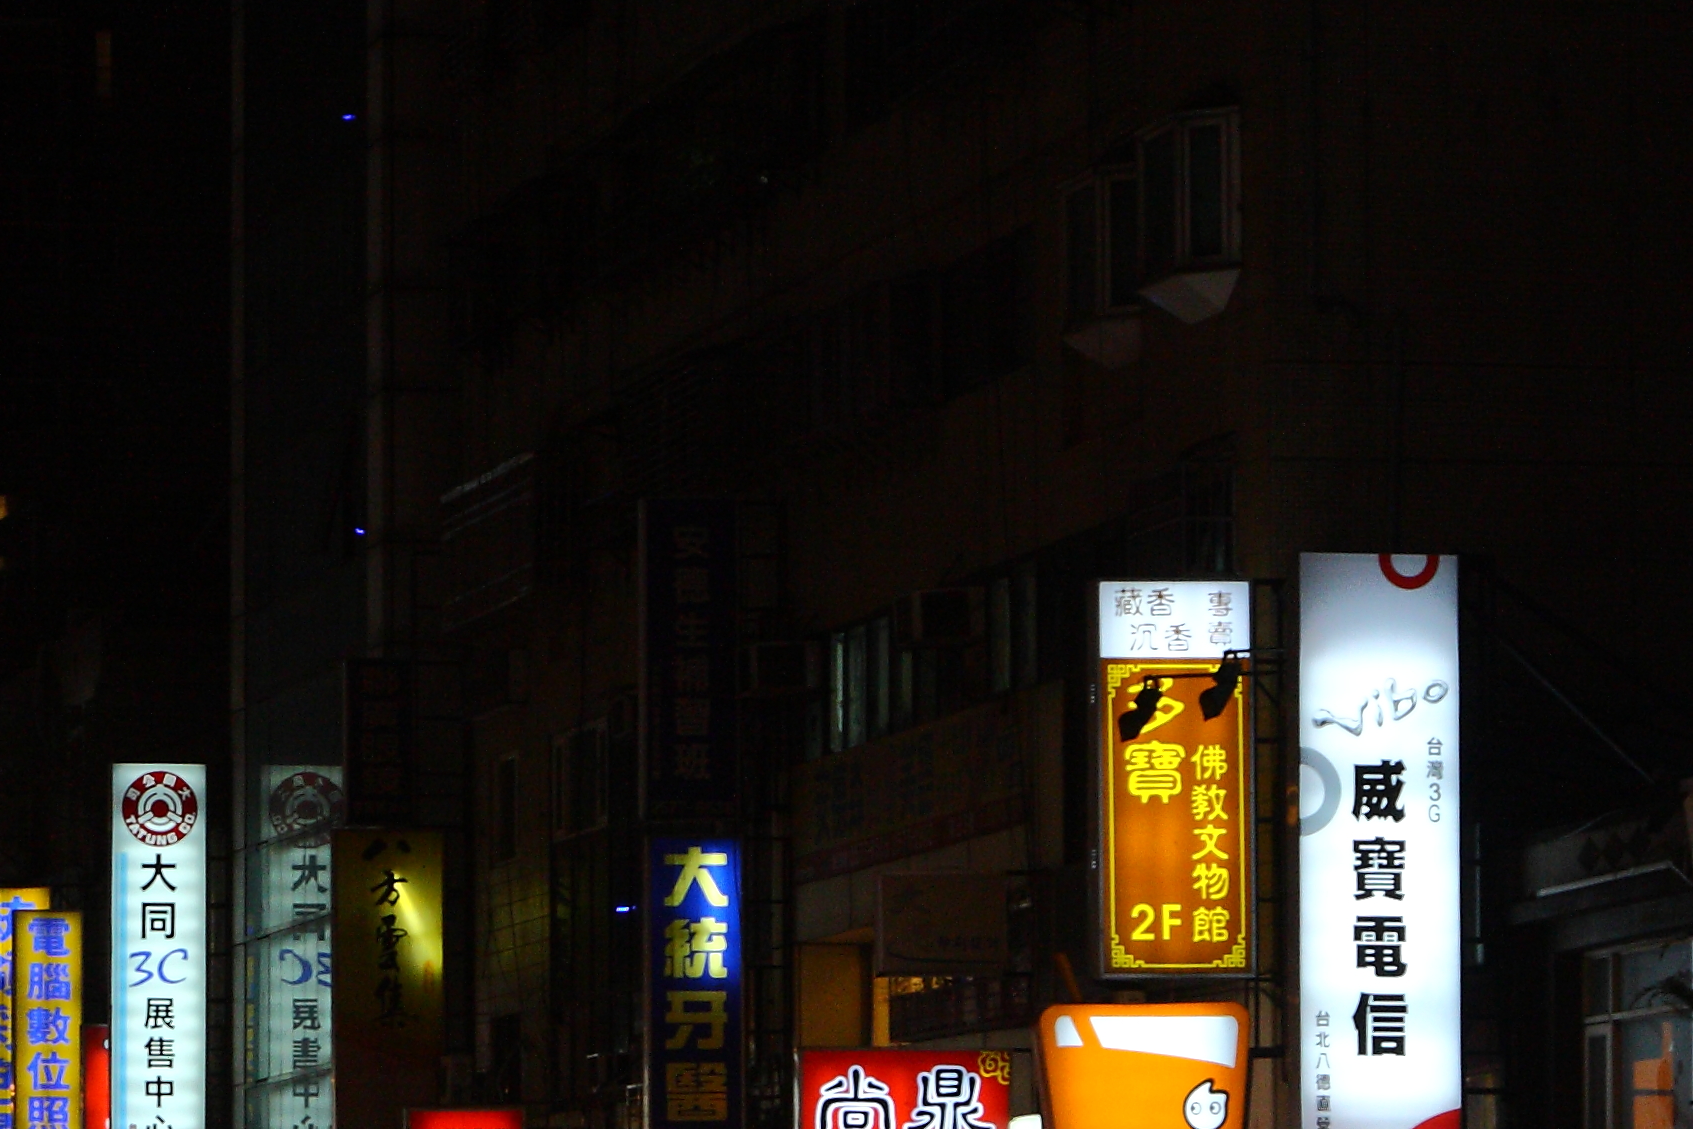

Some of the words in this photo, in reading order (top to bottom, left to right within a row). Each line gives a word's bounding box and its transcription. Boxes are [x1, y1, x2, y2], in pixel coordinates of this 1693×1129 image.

[1131, 904, 1182, 941] 2F
[1191, 744, 1230, 943] 佛教文物館
[1353, 759, 1408, 1057] 威寶電信
